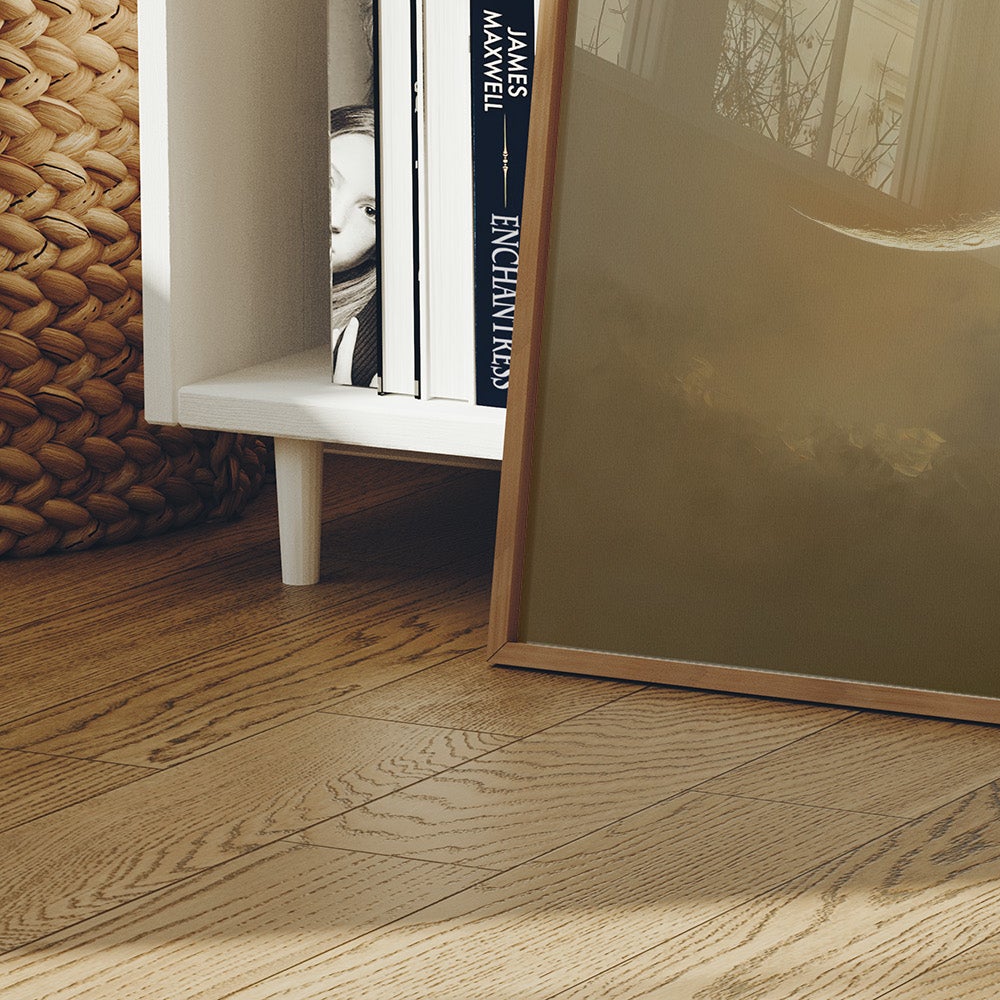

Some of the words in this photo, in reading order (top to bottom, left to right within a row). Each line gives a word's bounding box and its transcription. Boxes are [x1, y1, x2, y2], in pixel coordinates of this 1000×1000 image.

[483, 9, 503, 112] MAXWELL
[507, 26, 528, 97] JAMES
[490, 213, 520, 390] ENCHANTRESS
